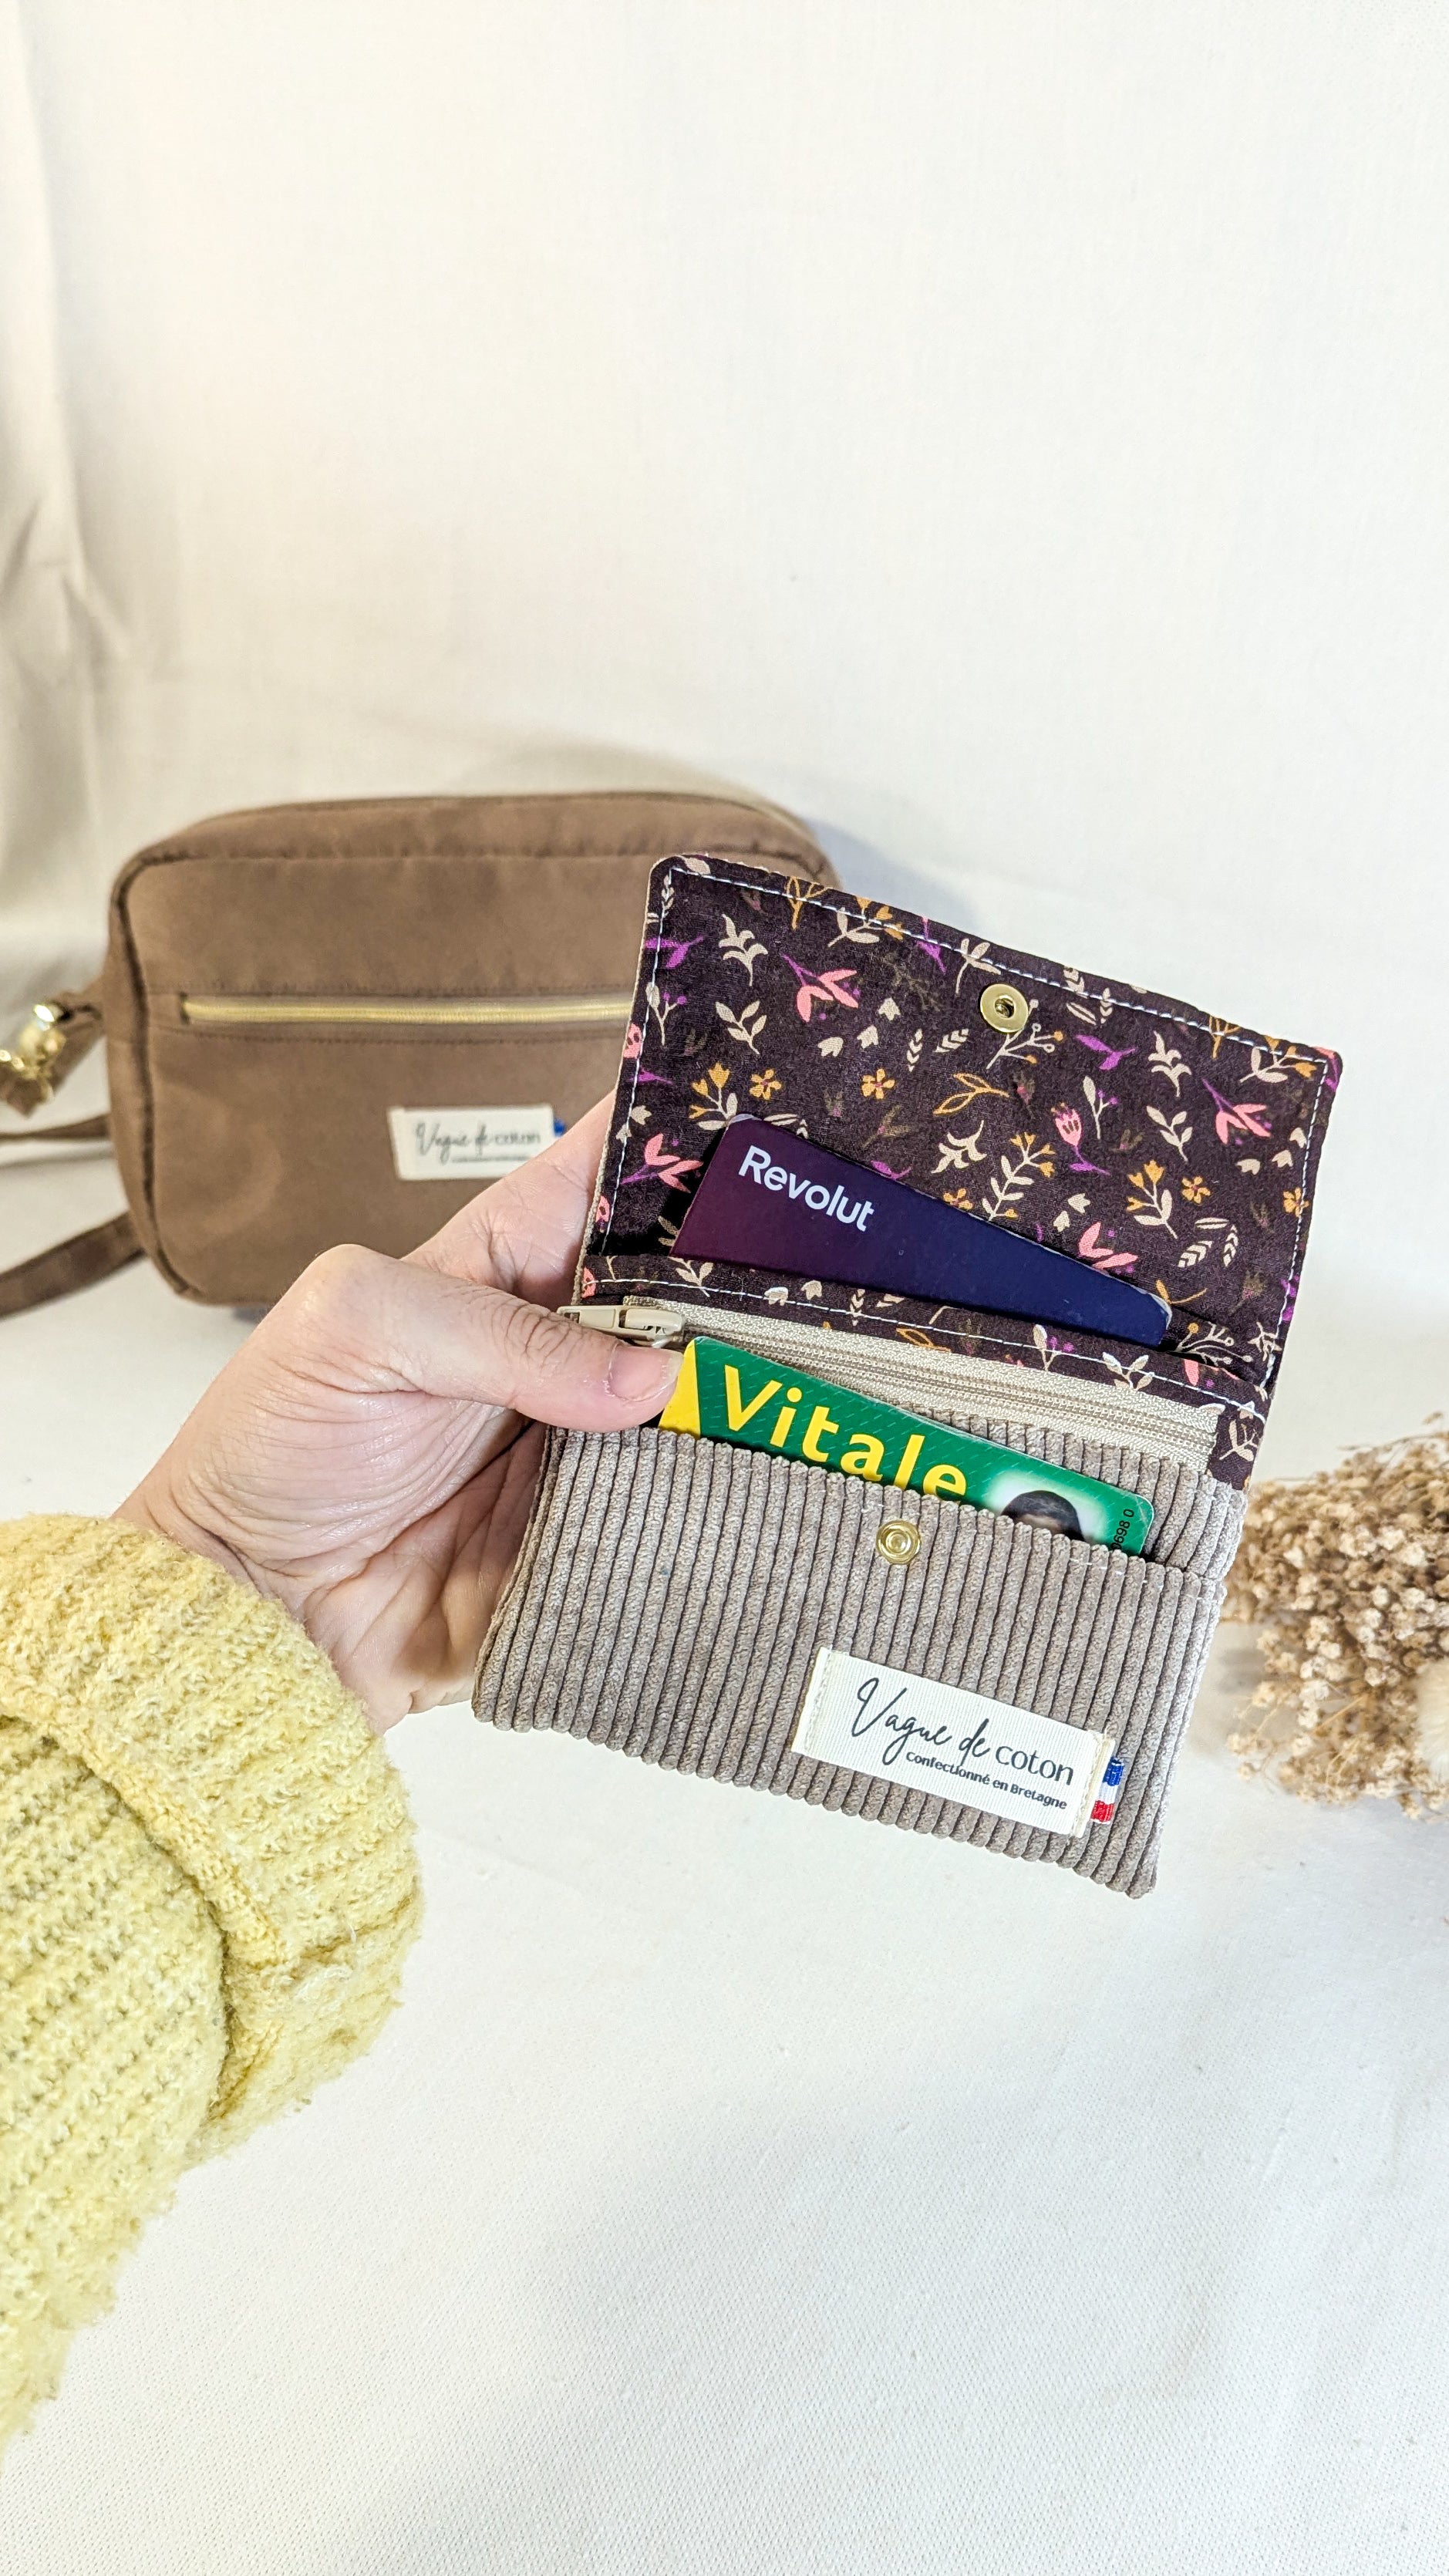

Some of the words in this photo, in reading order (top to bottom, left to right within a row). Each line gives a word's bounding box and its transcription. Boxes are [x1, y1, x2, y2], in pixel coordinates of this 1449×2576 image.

[738, 1145, 875, 1232] Revolut
[724, 1364, 966, 1497] Vitale
[852, 1677, 952, 1765] Vague
[959, 1718, 991, 1766] de
[995, 1745, 1074, 1785] coton
[906, 1752, 990, 1785] Confectionné
[992, 1779, 1009, 1791] en
[1009, 1784, 1067, 1810] Bretagne
